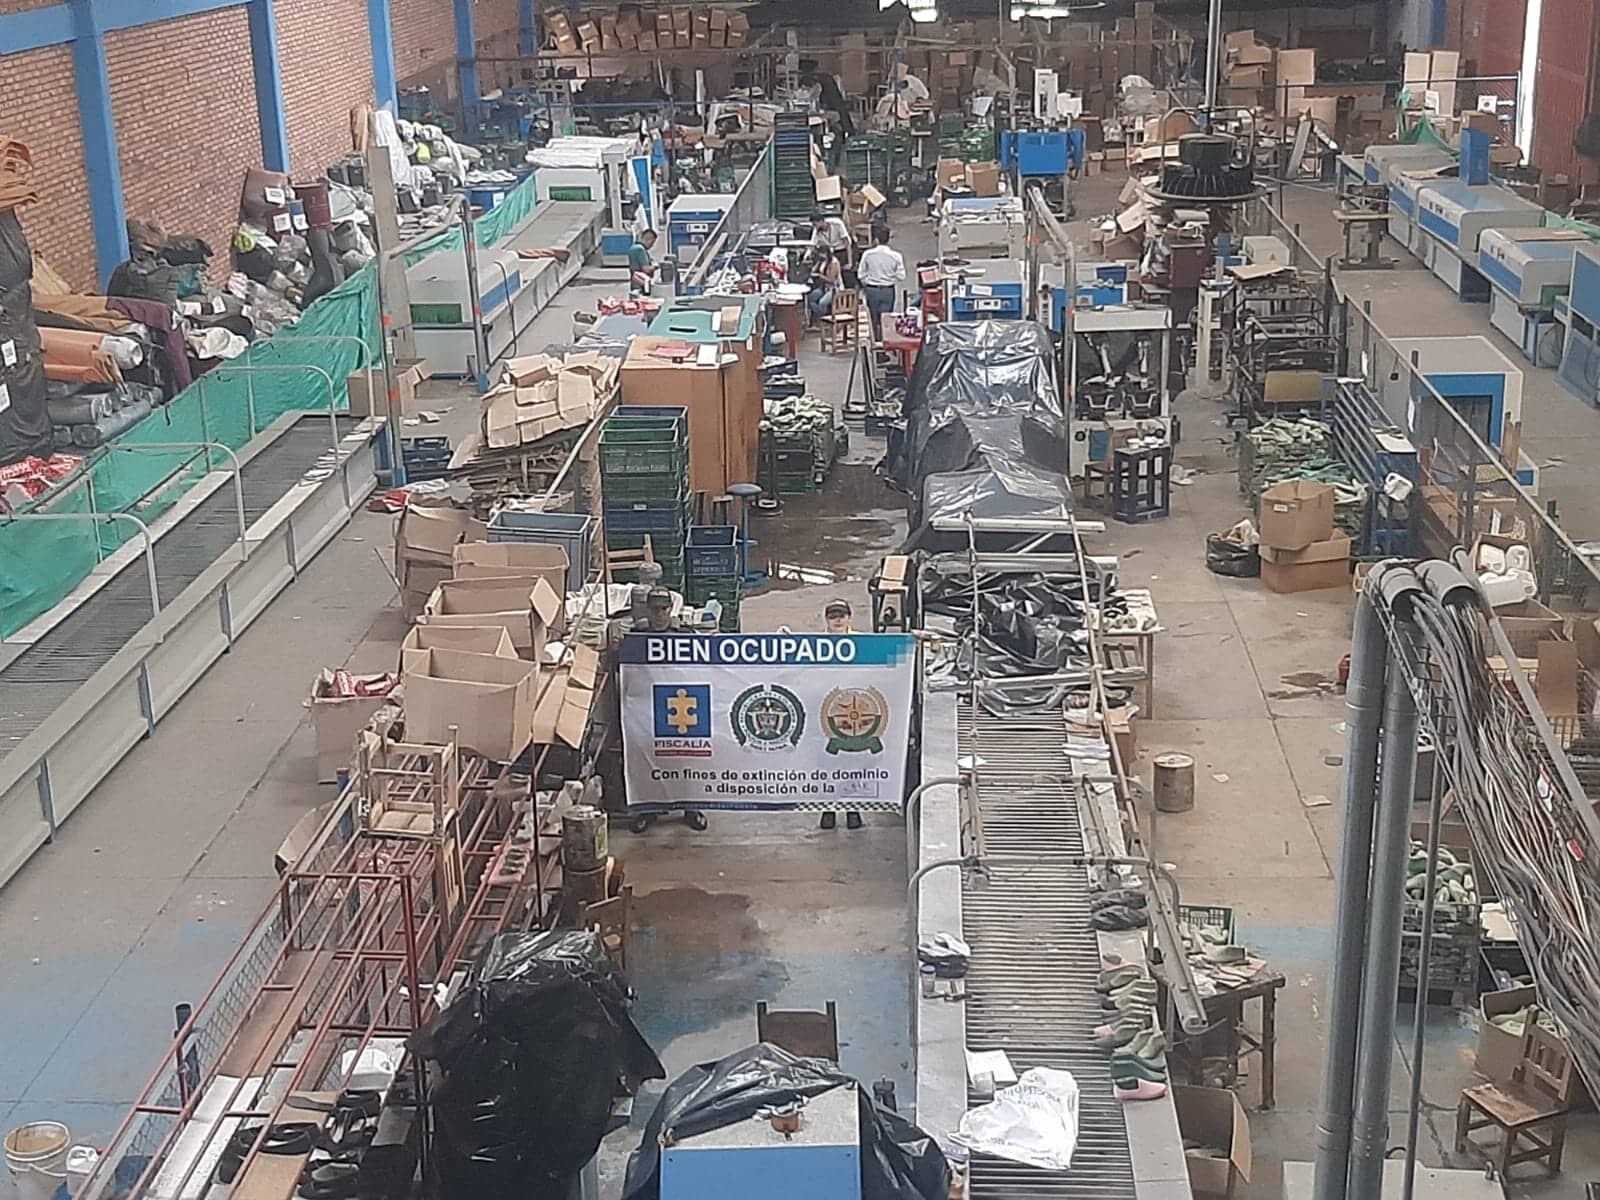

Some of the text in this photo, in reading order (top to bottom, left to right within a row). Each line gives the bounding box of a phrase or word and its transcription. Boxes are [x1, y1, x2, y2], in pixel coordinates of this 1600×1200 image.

[647, 638, 856, 662] BIEN OCUPADO
[651, 767, 889, 781] Con fines de extinción de dominio
[704, 784, 712, 793] a
[716, 783, 797, 795] disposición
[801, 783, 819, 793] de
[823, 782, 835, 793] la
